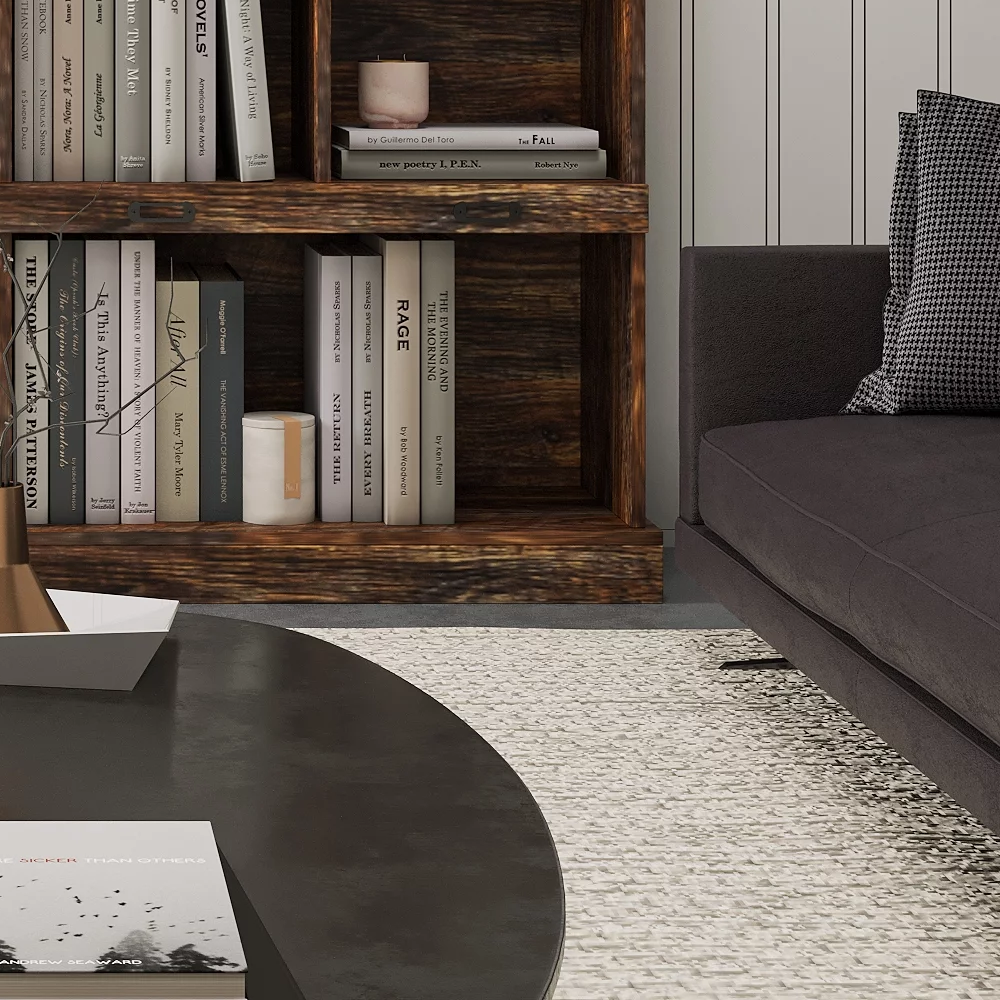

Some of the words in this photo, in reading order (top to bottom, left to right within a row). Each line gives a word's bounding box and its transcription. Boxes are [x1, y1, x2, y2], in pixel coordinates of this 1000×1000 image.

[367, 136, 378, 145] by
[380, 136, 419, 144] Guillermo
[421, 136, 435, 144] Del
[437, 136, 455, 144] Toro
[379, 161, 401, 169] new
[403, 160, 438, 171] poetry
[534, 161, 561, 169] Robert
[562, 161, 579, 170] Nye
[97, 293, 109, 306] Is
[218, 300, 226, 326] Maggie
[397, 300, 410, 351] RAGE
[97, 311, 109, 342] This
[25, 362, 38, 414] JAMES
[95, 346, 110, 419] Anything?
[173, 412, 183, 438] Mary
[25, 418, 38, 509] PATTERSON
[173, 439, 184, 465] Tyler
[175, 467, 184, 497] Moore
